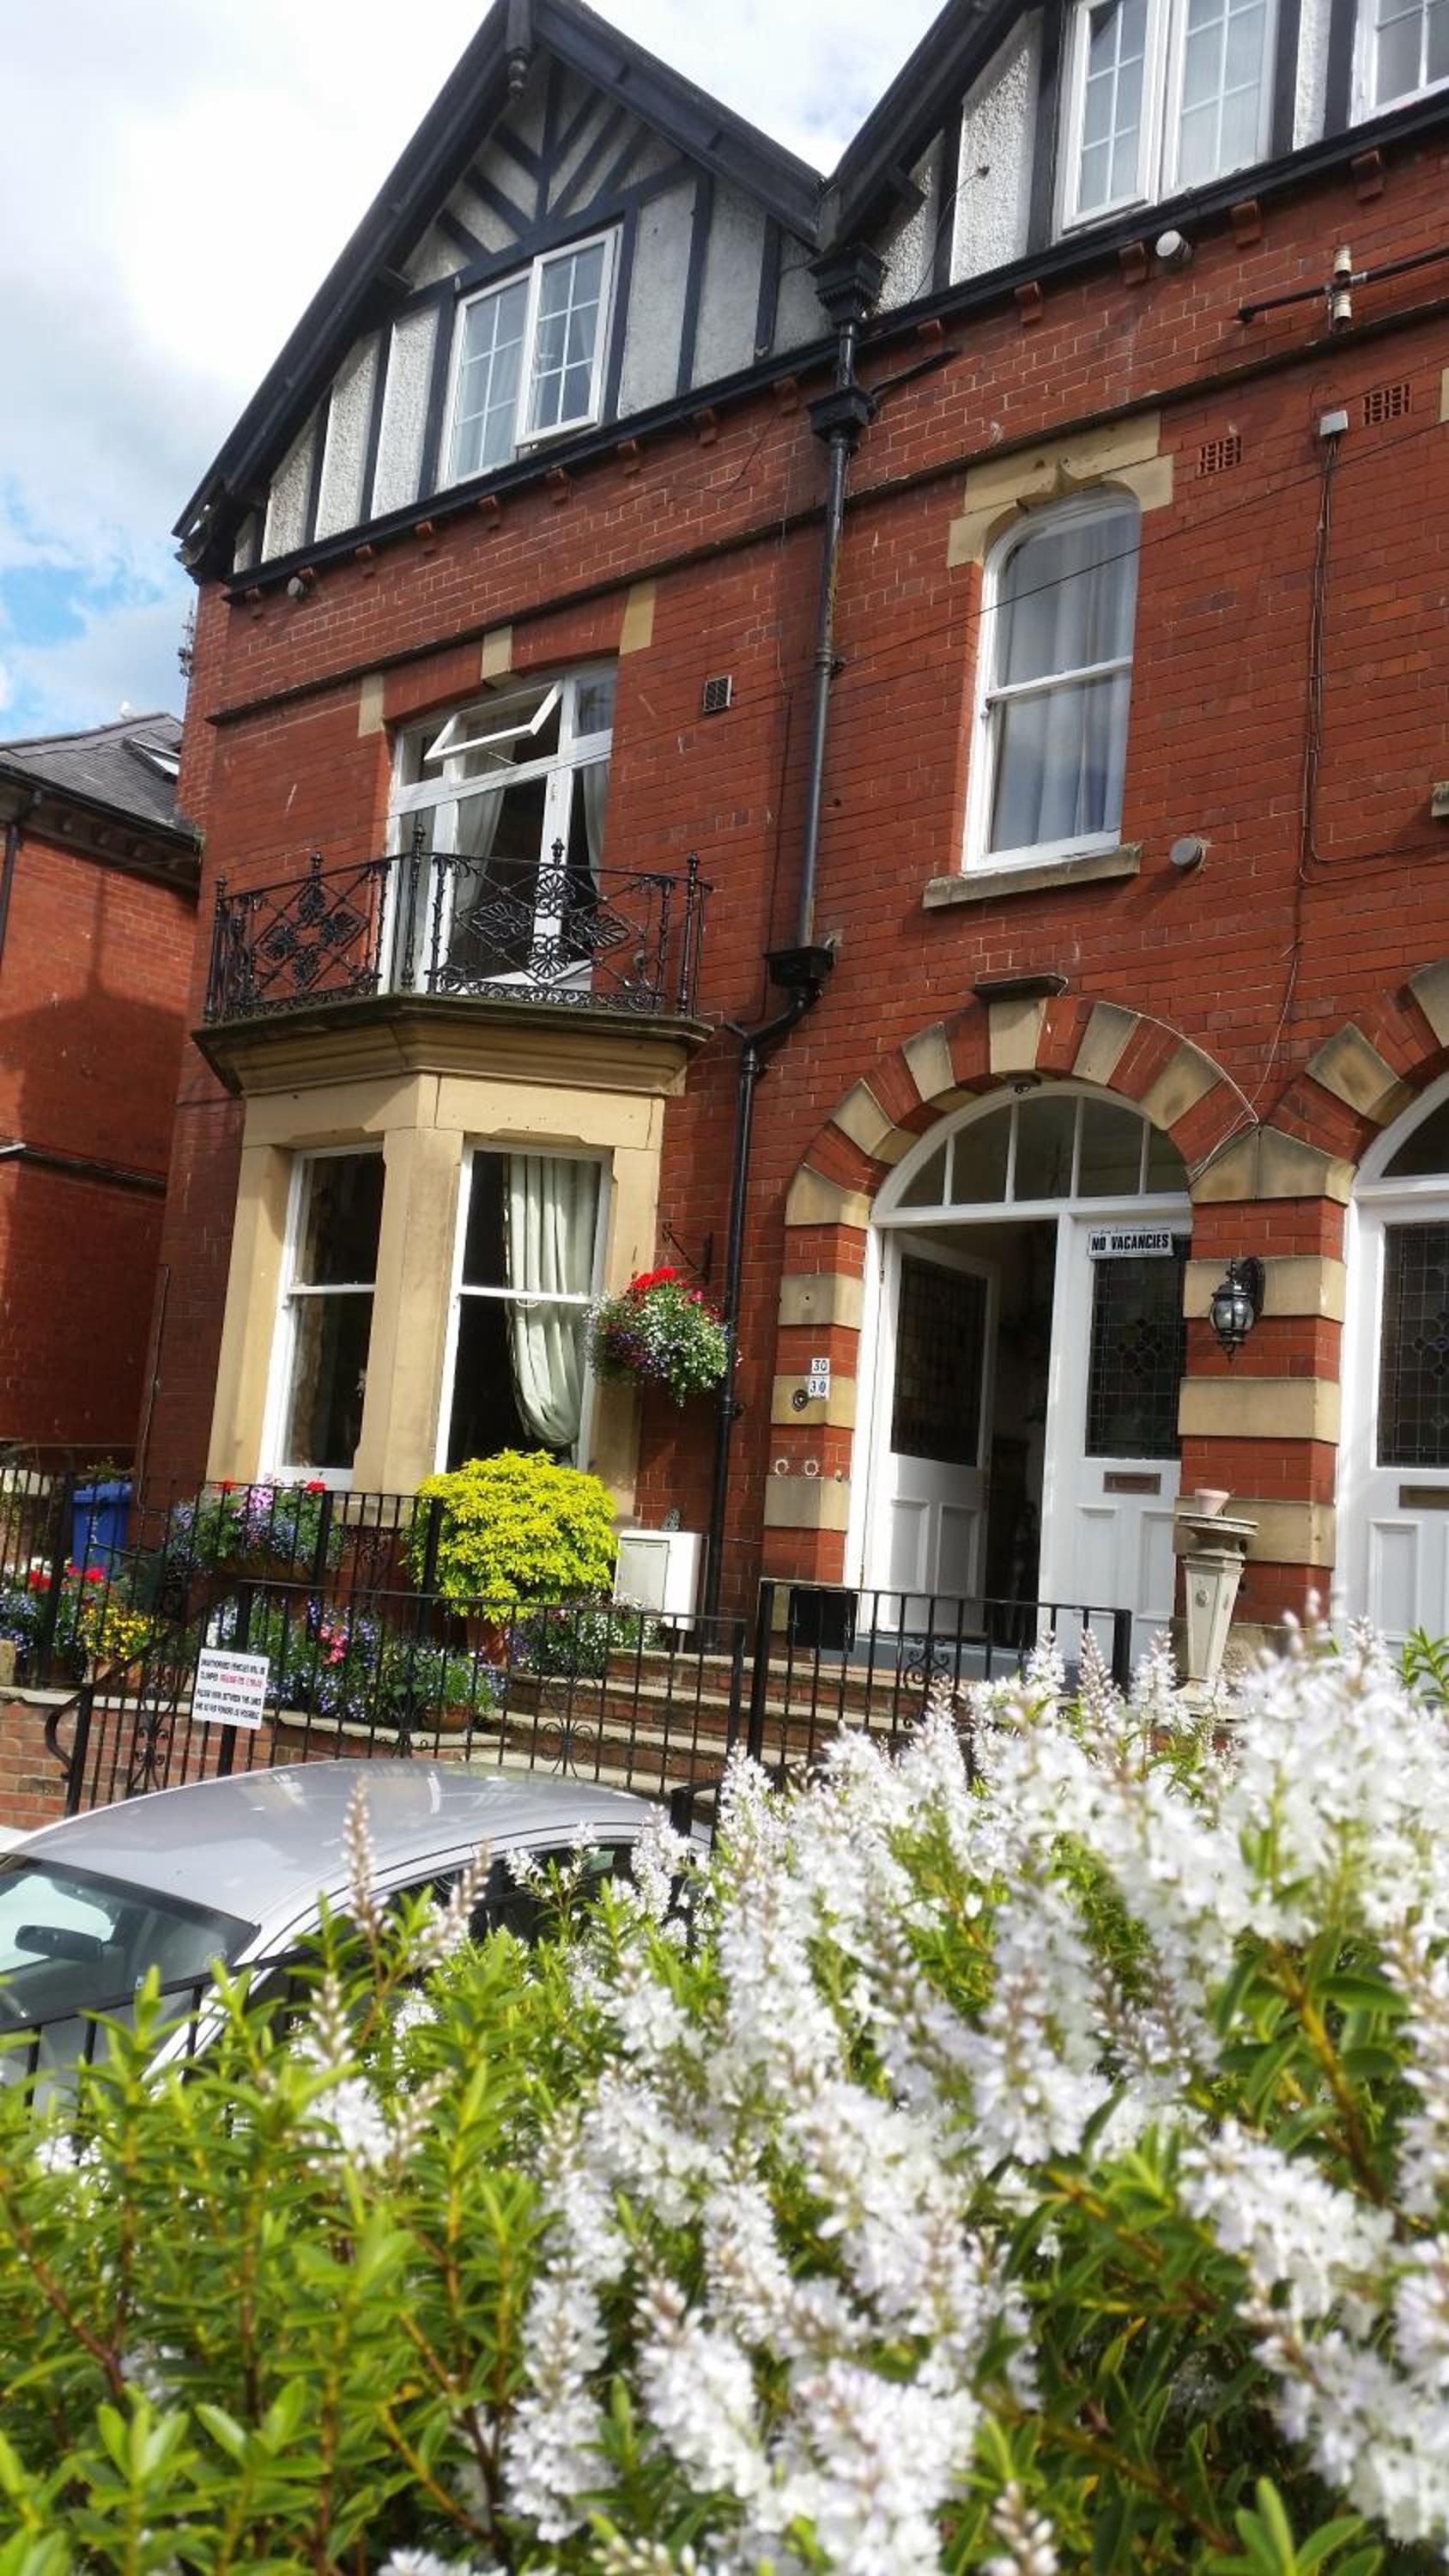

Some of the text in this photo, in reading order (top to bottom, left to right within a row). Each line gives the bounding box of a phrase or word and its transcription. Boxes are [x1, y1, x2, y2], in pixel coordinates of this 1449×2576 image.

[1091, 1234, 1168, 1250] NO VACANCIES
[814, 1359, 828, 1371] 30
